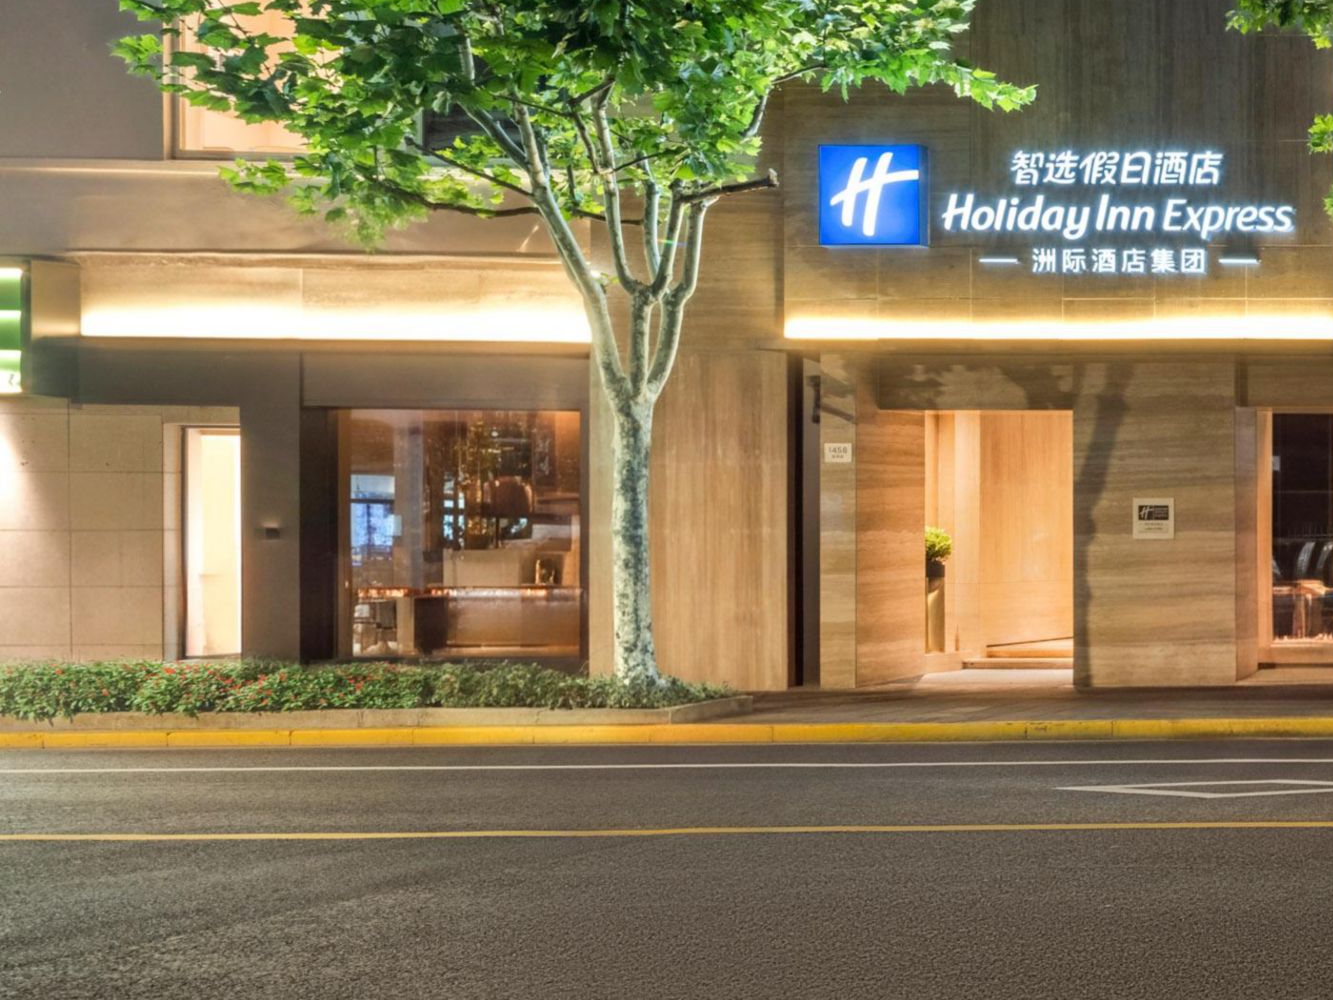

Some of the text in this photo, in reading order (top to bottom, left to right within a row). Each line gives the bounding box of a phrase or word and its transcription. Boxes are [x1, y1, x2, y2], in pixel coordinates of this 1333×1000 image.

[1010, 150, 1223, 185] 智选假日酒店
[941, 193, 1296, 240] Holiday Inn Express
[1032, 248, 1206, 273] 洲际酒店集团
